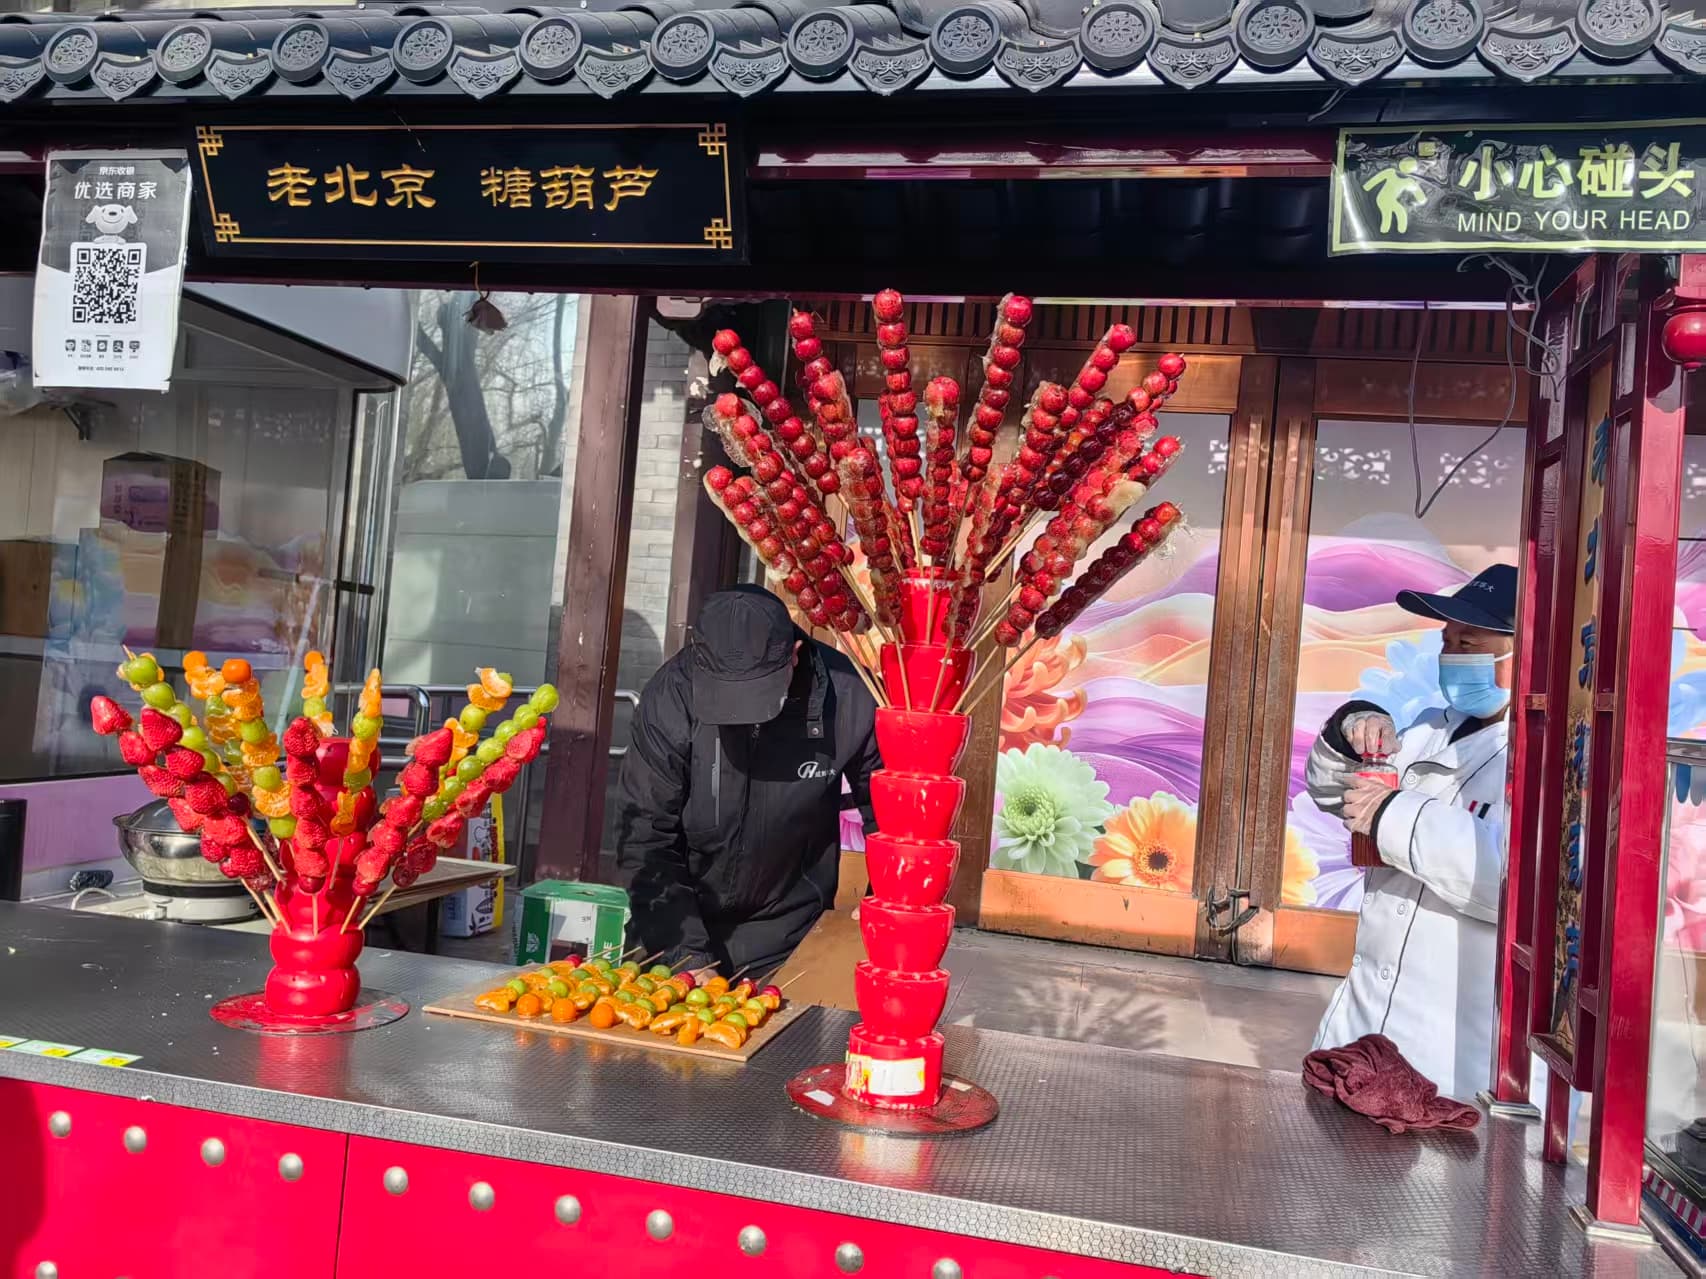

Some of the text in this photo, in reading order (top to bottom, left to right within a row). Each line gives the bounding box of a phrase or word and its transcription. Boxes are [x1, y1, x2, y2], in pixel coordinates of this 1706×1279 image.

[267, 162, 659, 211] 老北京 糖葫芦
[1458, 142, 1695, 200] 小心碰头
[74, 181, 158, 200] 优选商家
[1457, 210, 1690, 232] MIND YOUR HEAD
